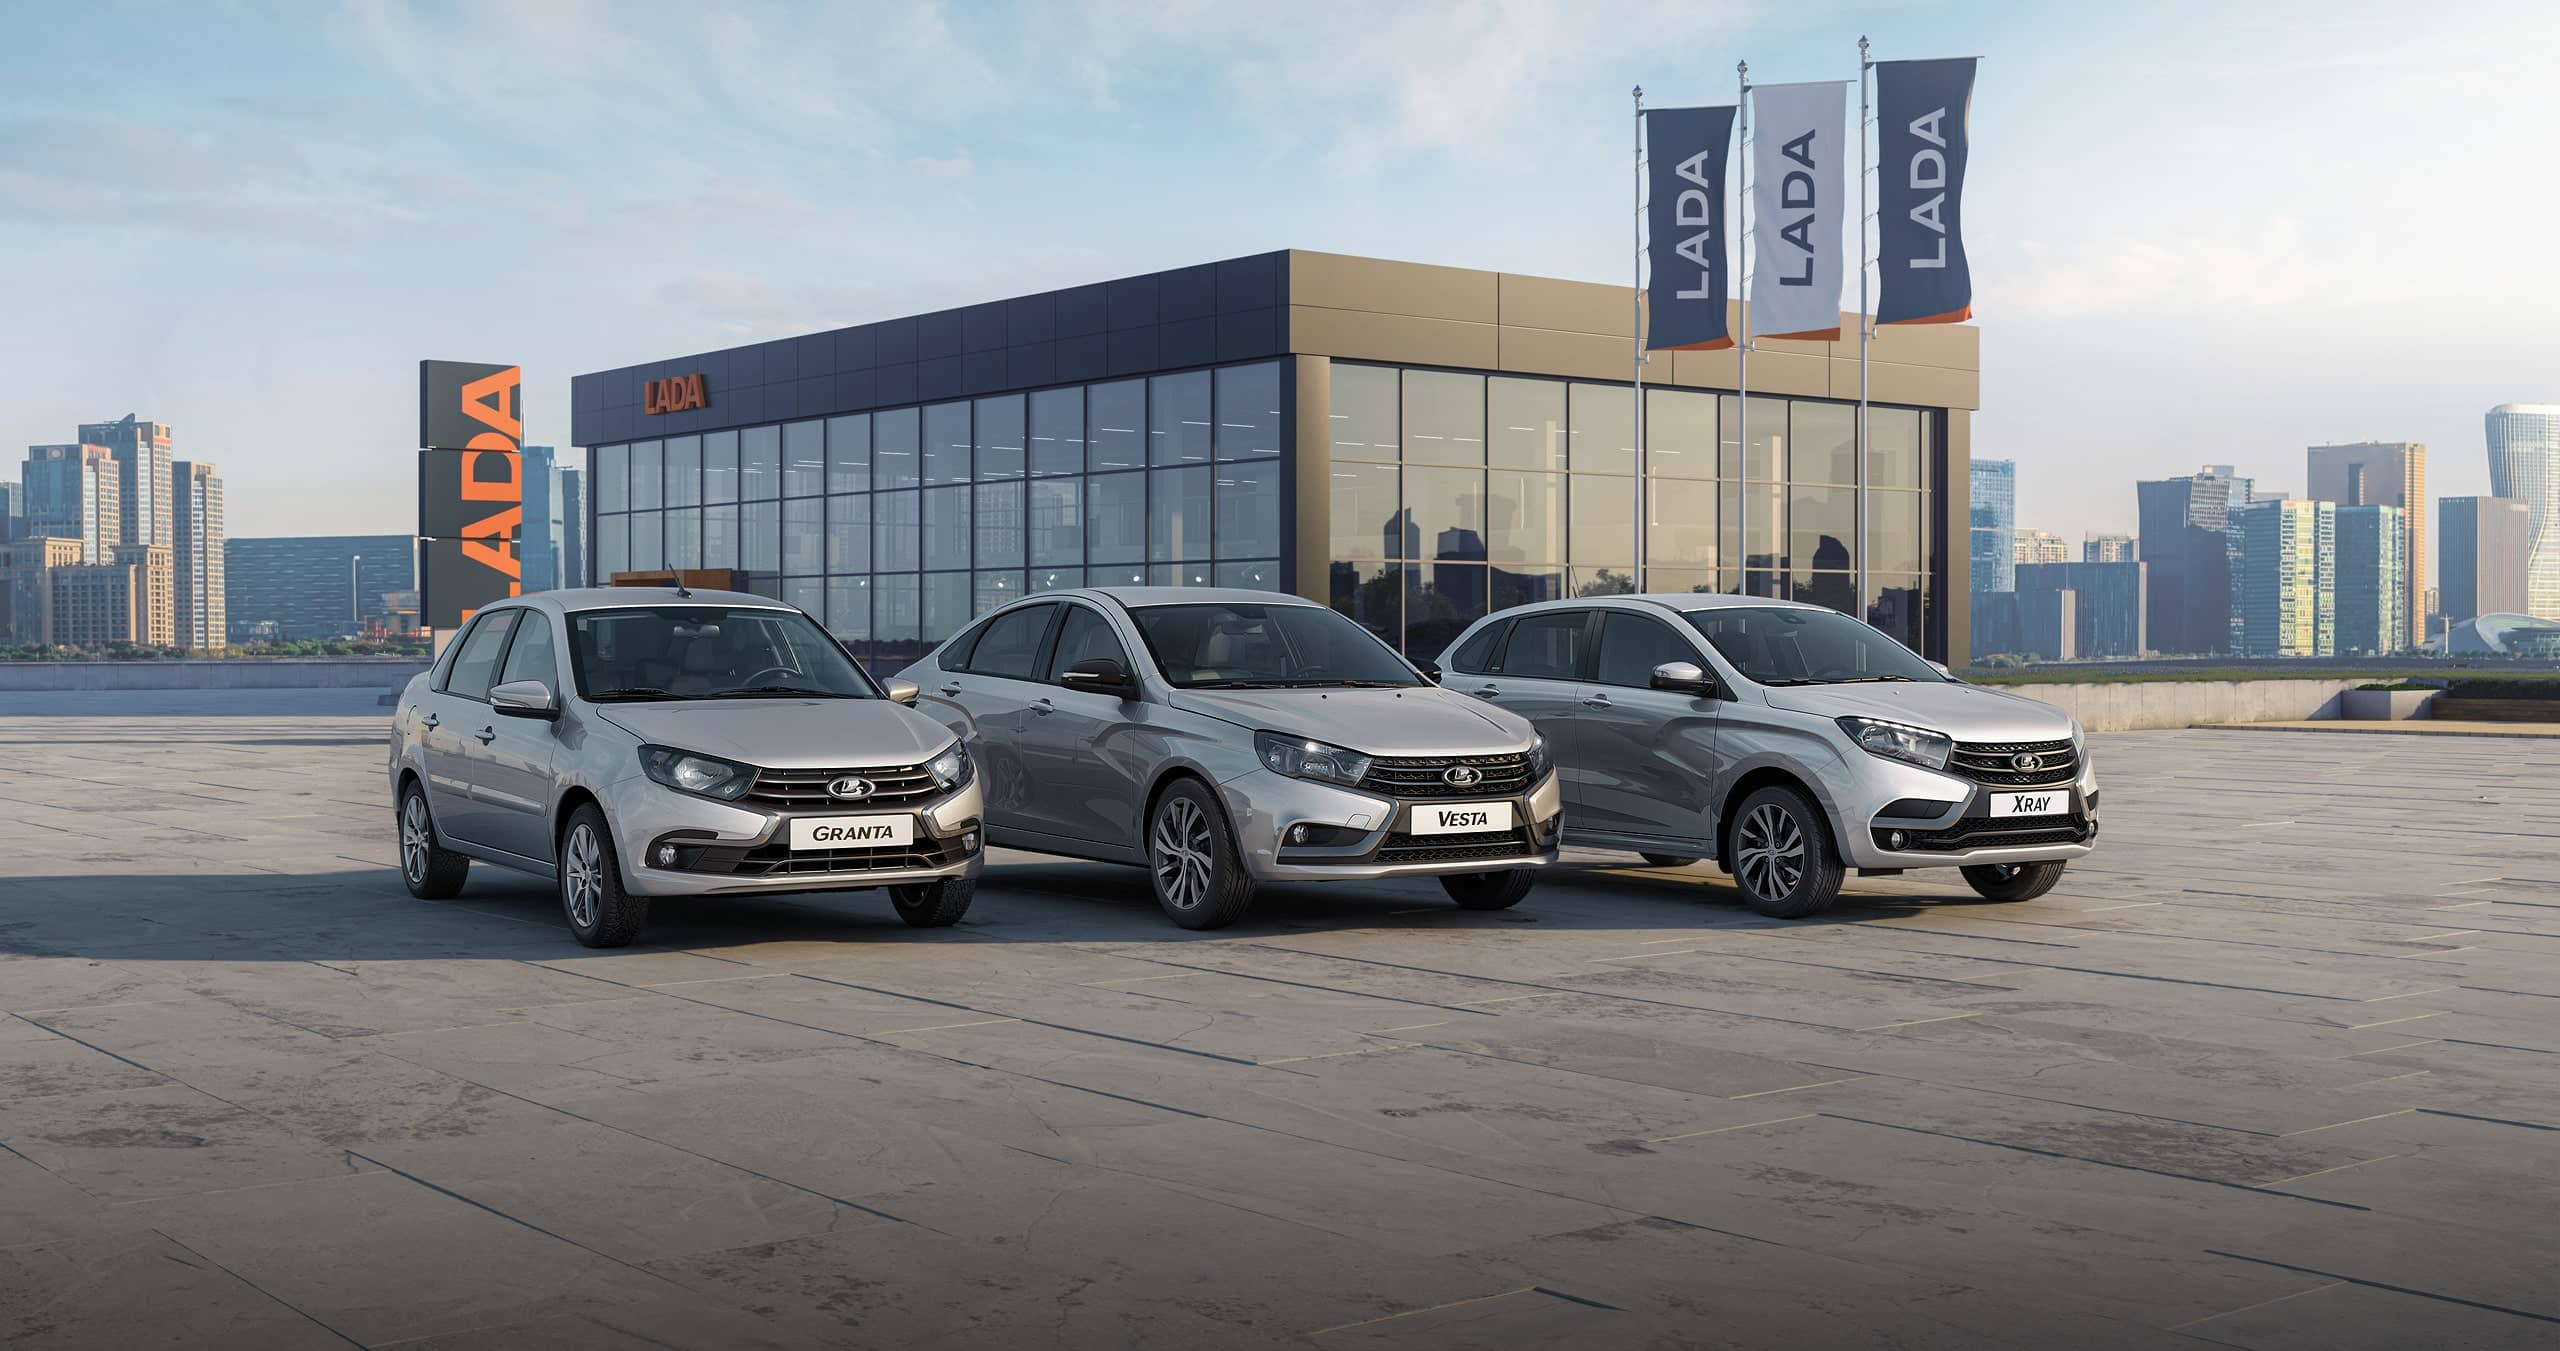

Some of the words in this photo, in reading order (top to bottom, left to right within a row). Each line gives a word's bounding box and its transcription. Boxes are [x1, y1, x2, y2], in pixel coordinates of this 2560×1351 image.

[1675, 149, 1709, 300] LADA
[1779, 128, 1816, 287] LADA
[1909, 106, 1947, 269] LADA
[644, 373, 705, 416] LADA
[812, 825, 893, 842] GRANTA
